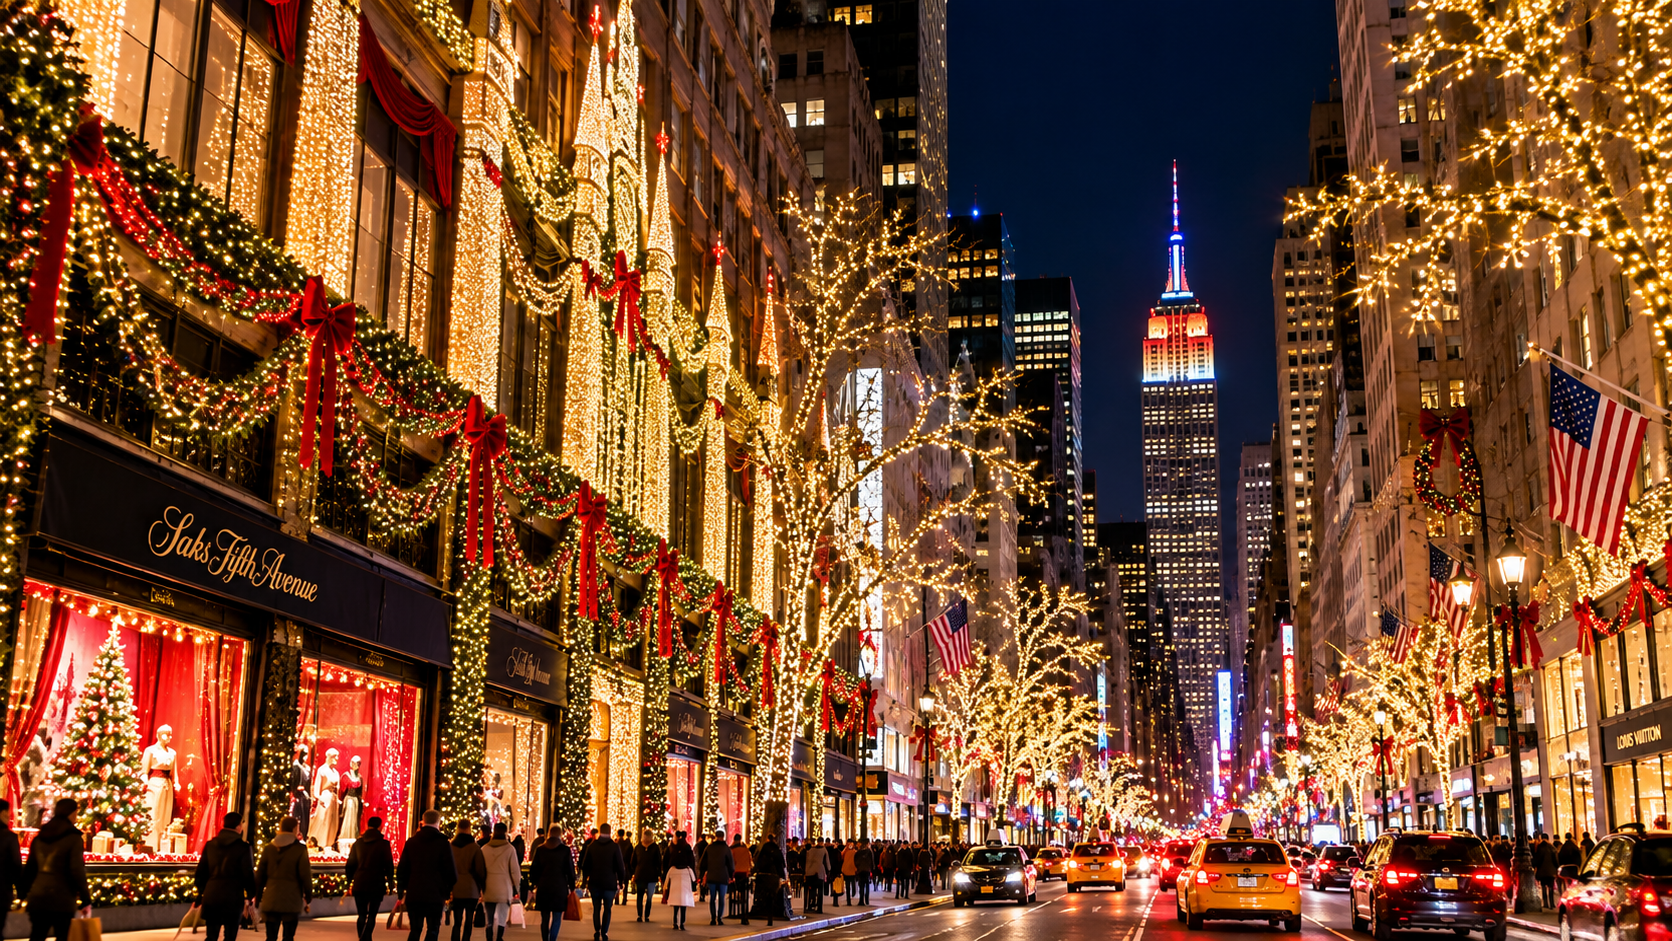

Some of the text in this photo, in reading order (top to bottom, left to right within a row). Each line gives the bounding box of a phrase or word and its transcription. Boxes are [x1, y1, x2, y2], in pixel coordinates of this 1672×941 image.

[148, 506, 318, 602] Saks Fifth Avenue
[1616, 724, 1662, 750] LOUIS VUITTON
